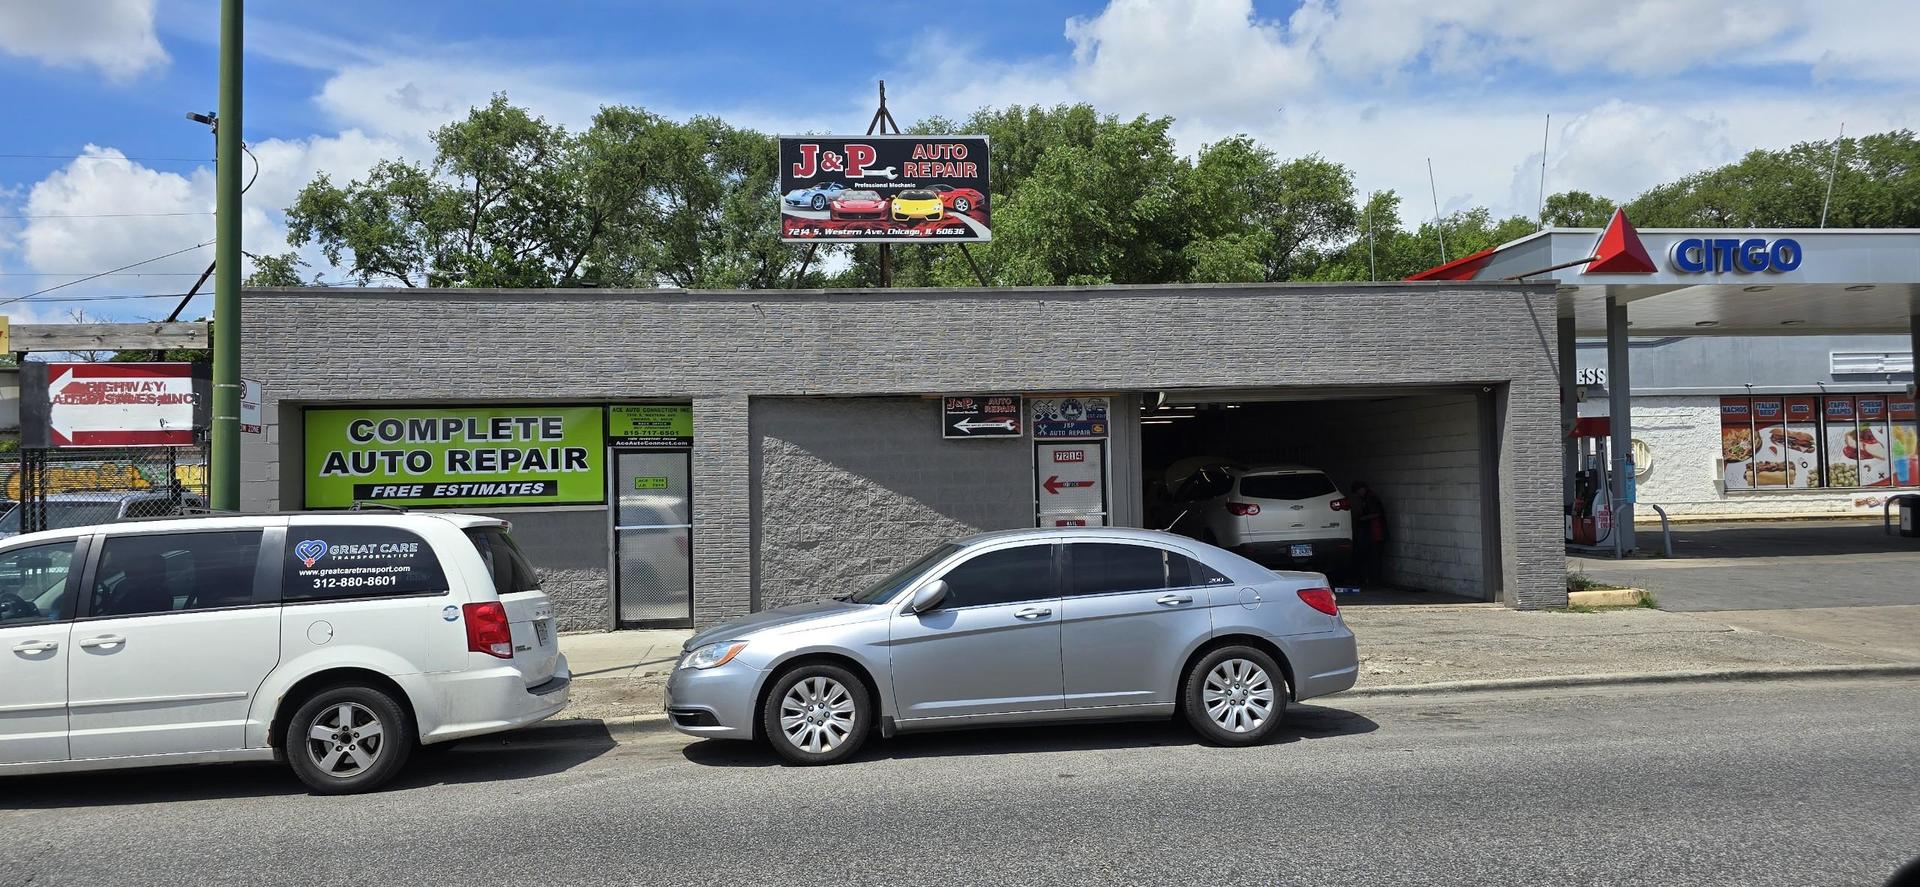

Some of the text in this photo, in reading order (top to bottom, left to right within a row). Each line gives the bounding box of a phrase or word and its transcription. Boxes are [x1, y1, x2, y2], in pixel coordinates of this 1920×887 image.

[912, 143, 968, 160] AUTO
[793, 143, 877, 179] J&P
[903, 161, 978, 179] REPAIR
[788, 228, 810, 236] 7214
[824, 228, 862, 236] Western
[864, 228, 885, 236] Ave.
[887, 228, 923, 236] Chicago,
[1672, 238, 1802, 273] CITGO
[1722, 405, 1748, 413] NACHOS
[1756, 402, 1780, 410] ITALIAN
[347, 416, 564, 444] COMPLETE
[319, 446, 591, 478] AUTO REPAIR
[1056, 452, 1082, 460] 7214
[370, 482, 545, 498] FREE ESTIMATES
[329, 542, 419, 556] GREAT CARE
[332, 553, 416, 561] TRANSPORTATION
[299, 565, 411, 577] www.greatcaretransport.com
[313, 576, 397, 589] 312-880-8601
